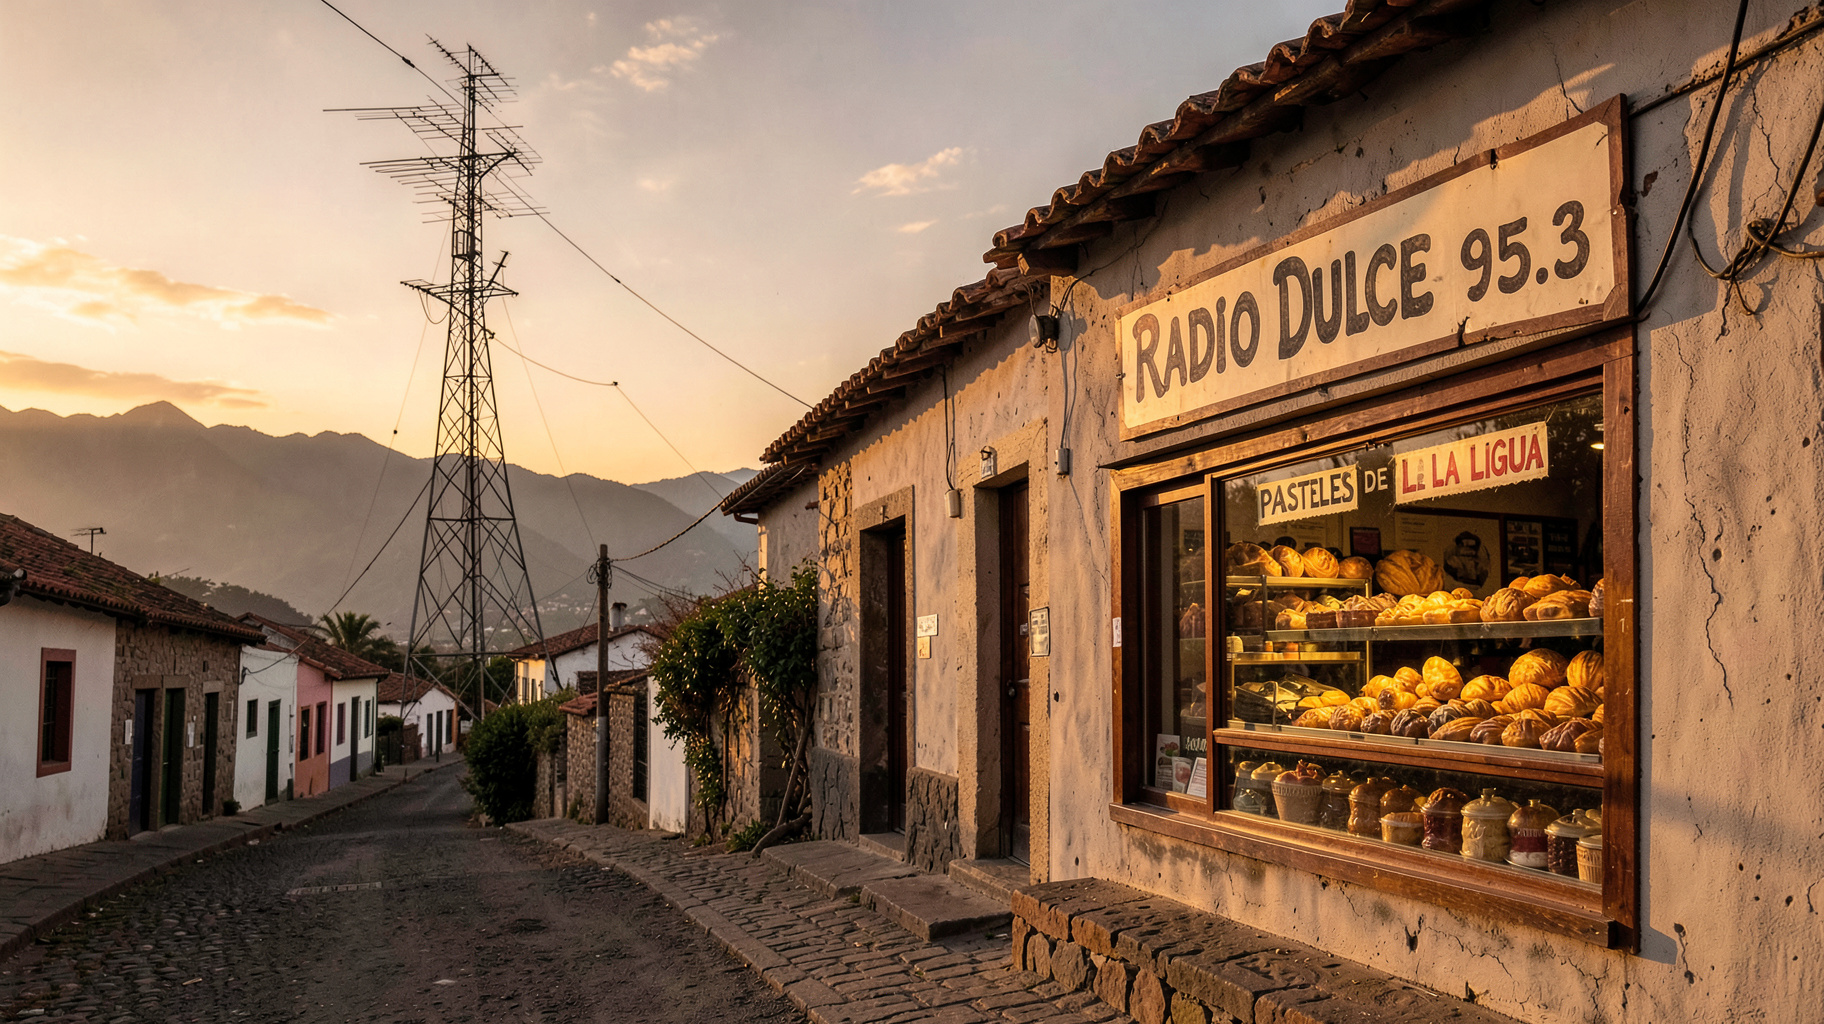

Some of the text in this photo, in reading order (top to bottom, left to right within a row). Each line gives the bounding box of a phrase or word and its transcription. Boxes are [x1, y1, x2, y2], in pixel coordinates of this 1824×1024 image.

[1132, 200, 1591, 404] RADIO DULCE 95.3
[1260, 471, 1355, 519] PASTELES
[1364, 467, 1388, 494] DE
[1431, 450, 1460, 488] LA
[1470, 434, 1544, 481] LIGUA
